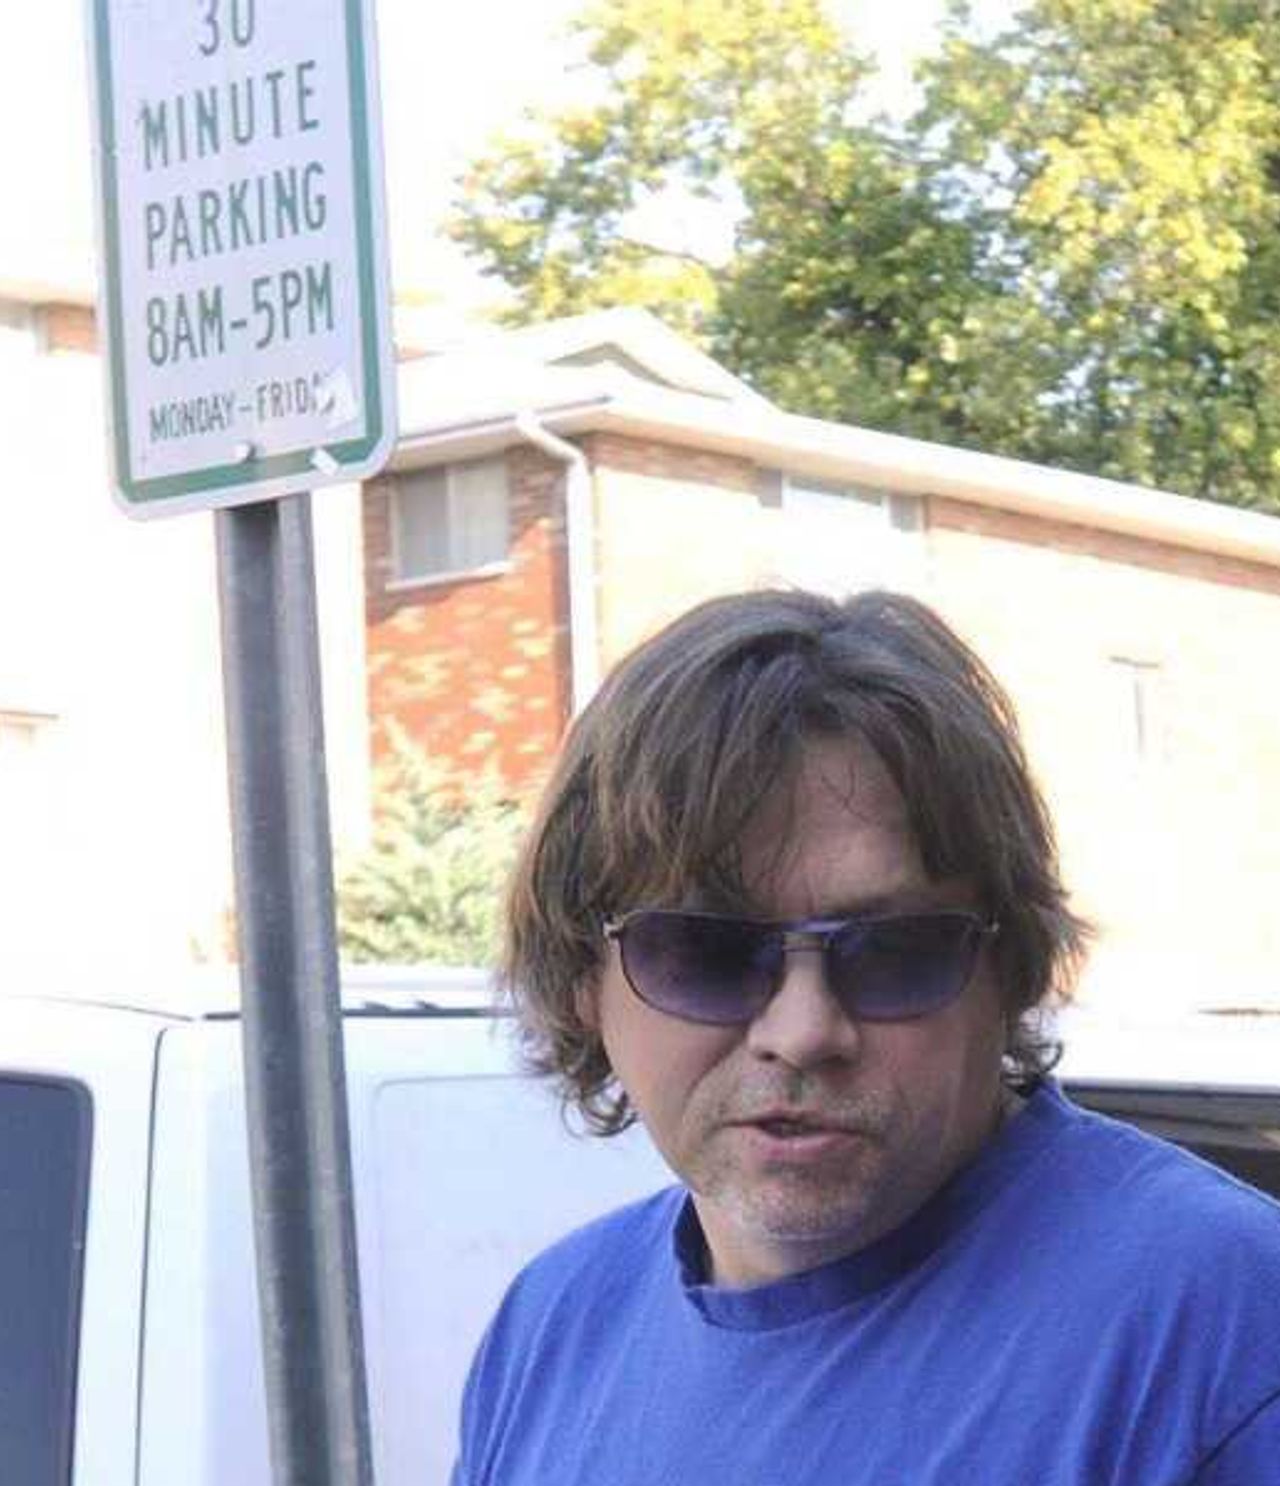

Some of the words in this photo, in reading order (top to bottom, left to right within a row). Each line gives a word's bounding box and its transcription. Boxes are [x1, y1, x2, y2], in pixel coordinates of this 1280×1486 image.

[198, 0, 254, 56] 30
[137, 60, 320, 172] MINUTE
[145, 161, 327, 270] PARKING
[147, 261, 334, 367] 8AM-5PM
